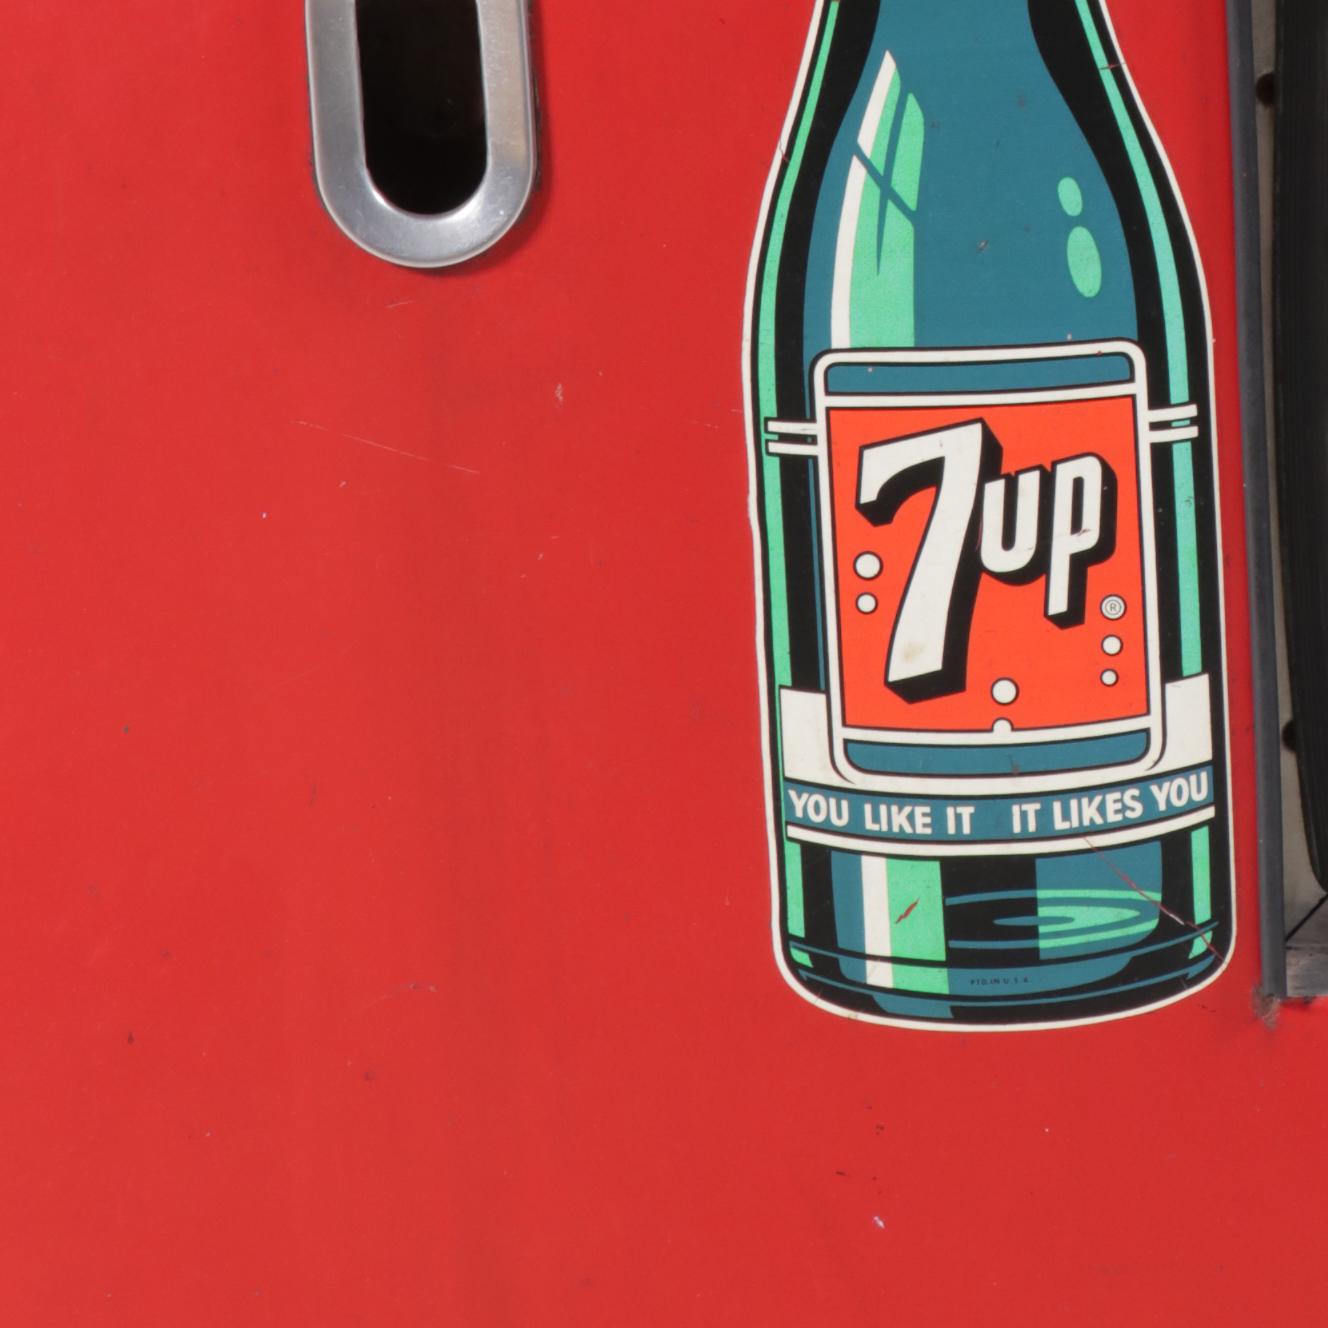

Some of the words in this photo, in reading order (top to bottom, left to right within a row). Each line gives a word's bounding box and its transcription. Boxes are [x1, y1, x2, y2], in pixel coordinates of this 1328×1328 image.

[788, 789, 849, 827] YOU
[863, 803, 933, 835] LIKE
[946, 805, 975, 835] IT
[1011, 802, 1041, 834] IT
[1052, 788, 1144, 831] LIKES
[1150, 770, 1209, 812] YOU
